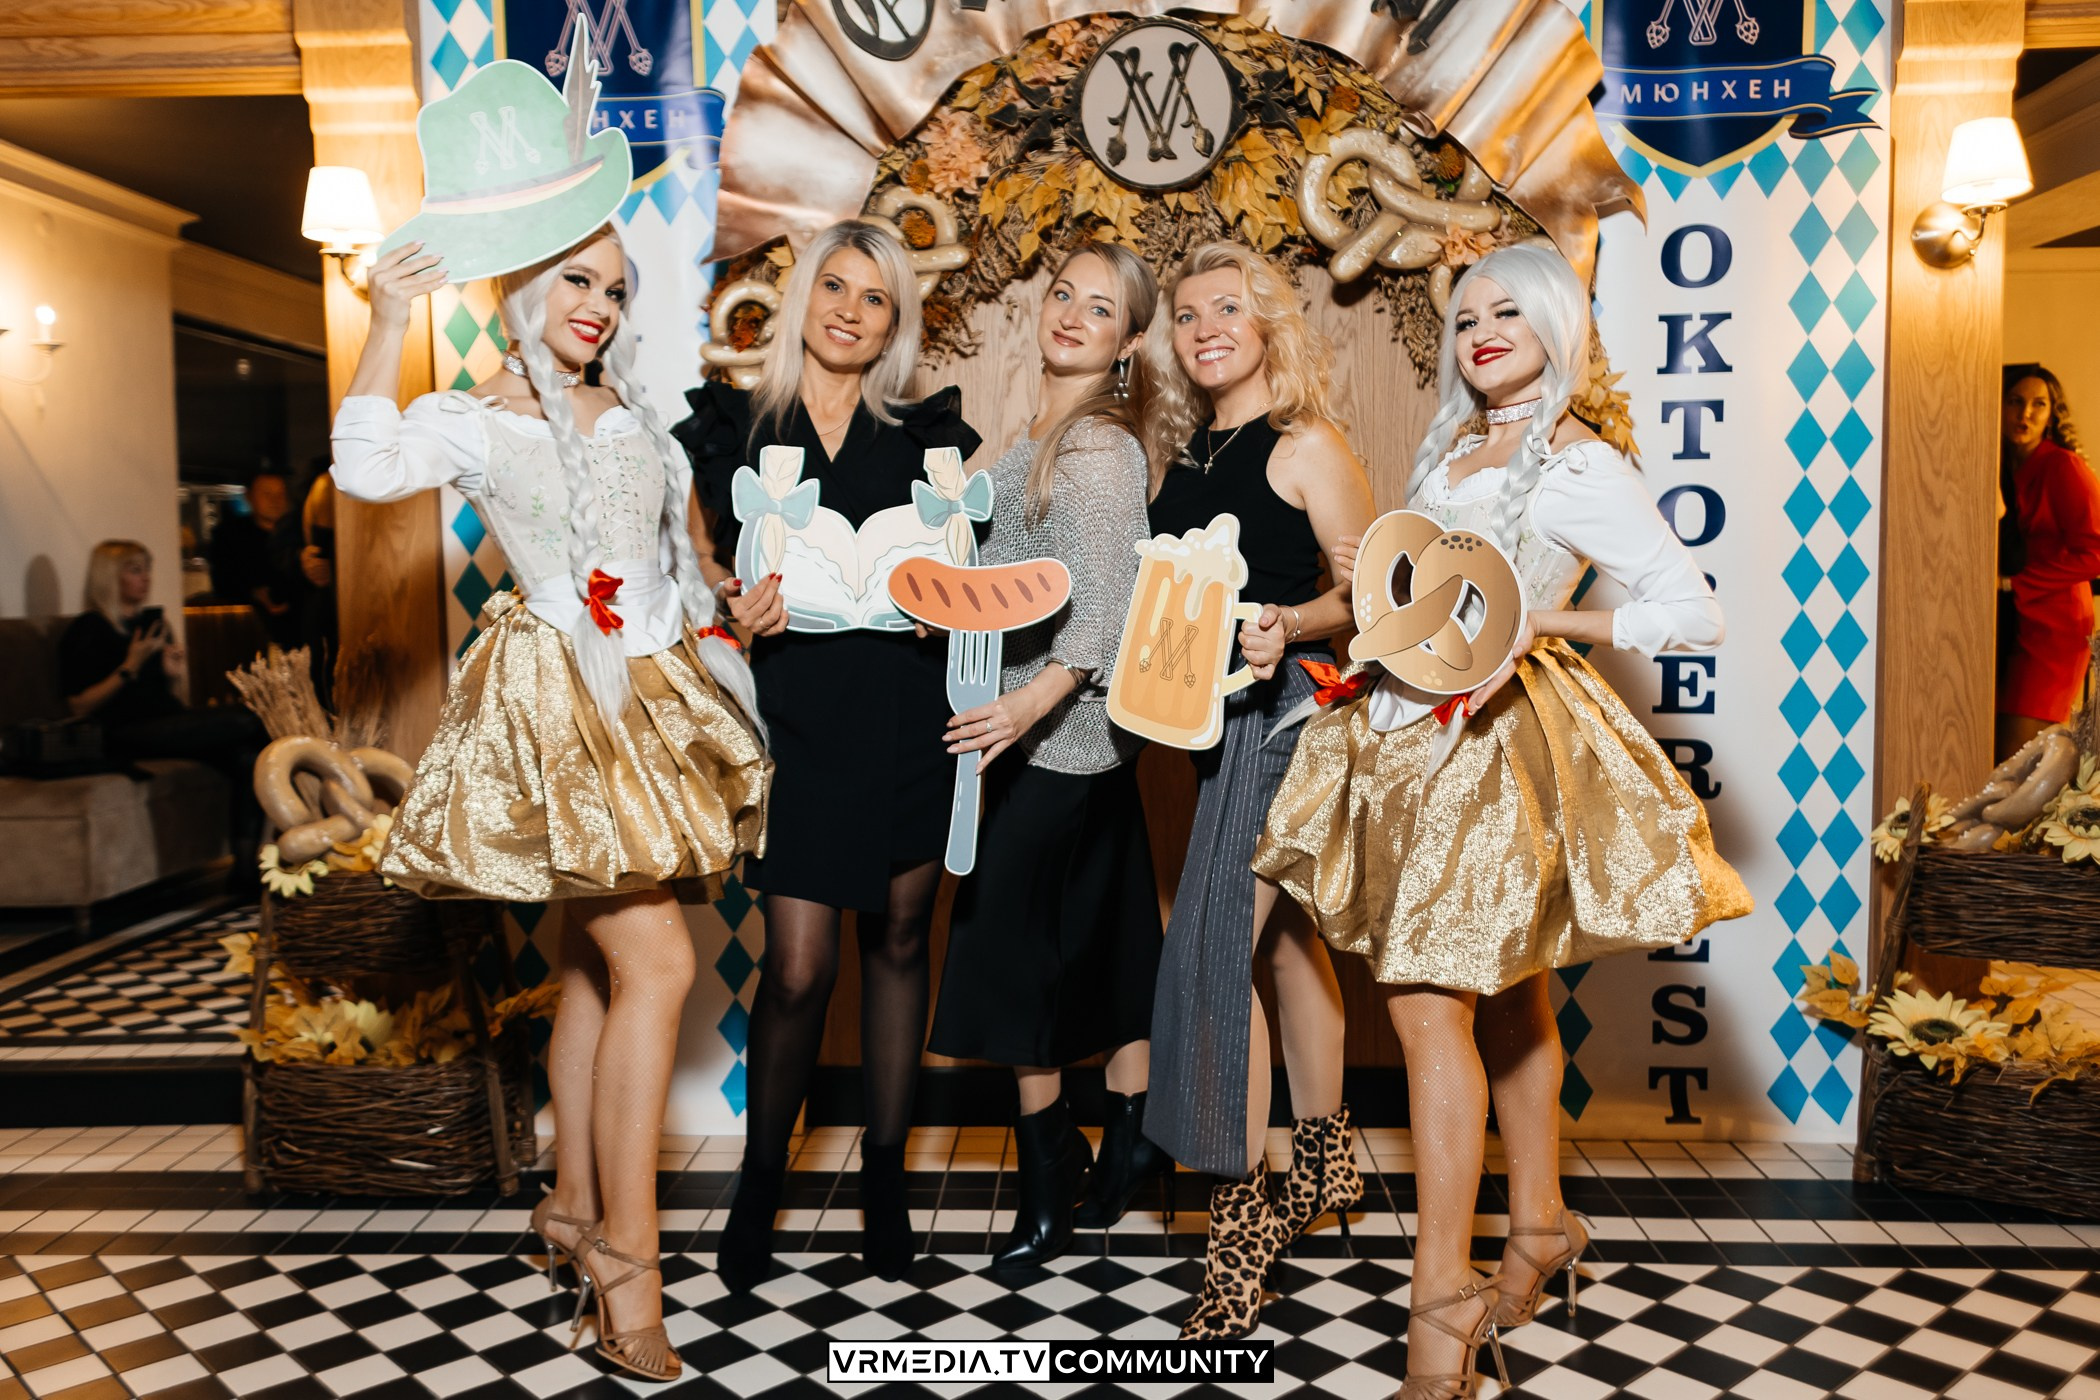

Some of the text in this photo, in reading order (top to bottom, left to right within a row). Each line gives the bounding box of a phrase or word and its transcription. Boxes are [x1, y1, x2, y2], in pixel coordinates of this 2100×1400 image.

[1620, 79, 1791, 104] МЮНХЕН
[592, 109, 686, 129] НХЕН
[1647, 223, 1733, 1125] OKTOERST
